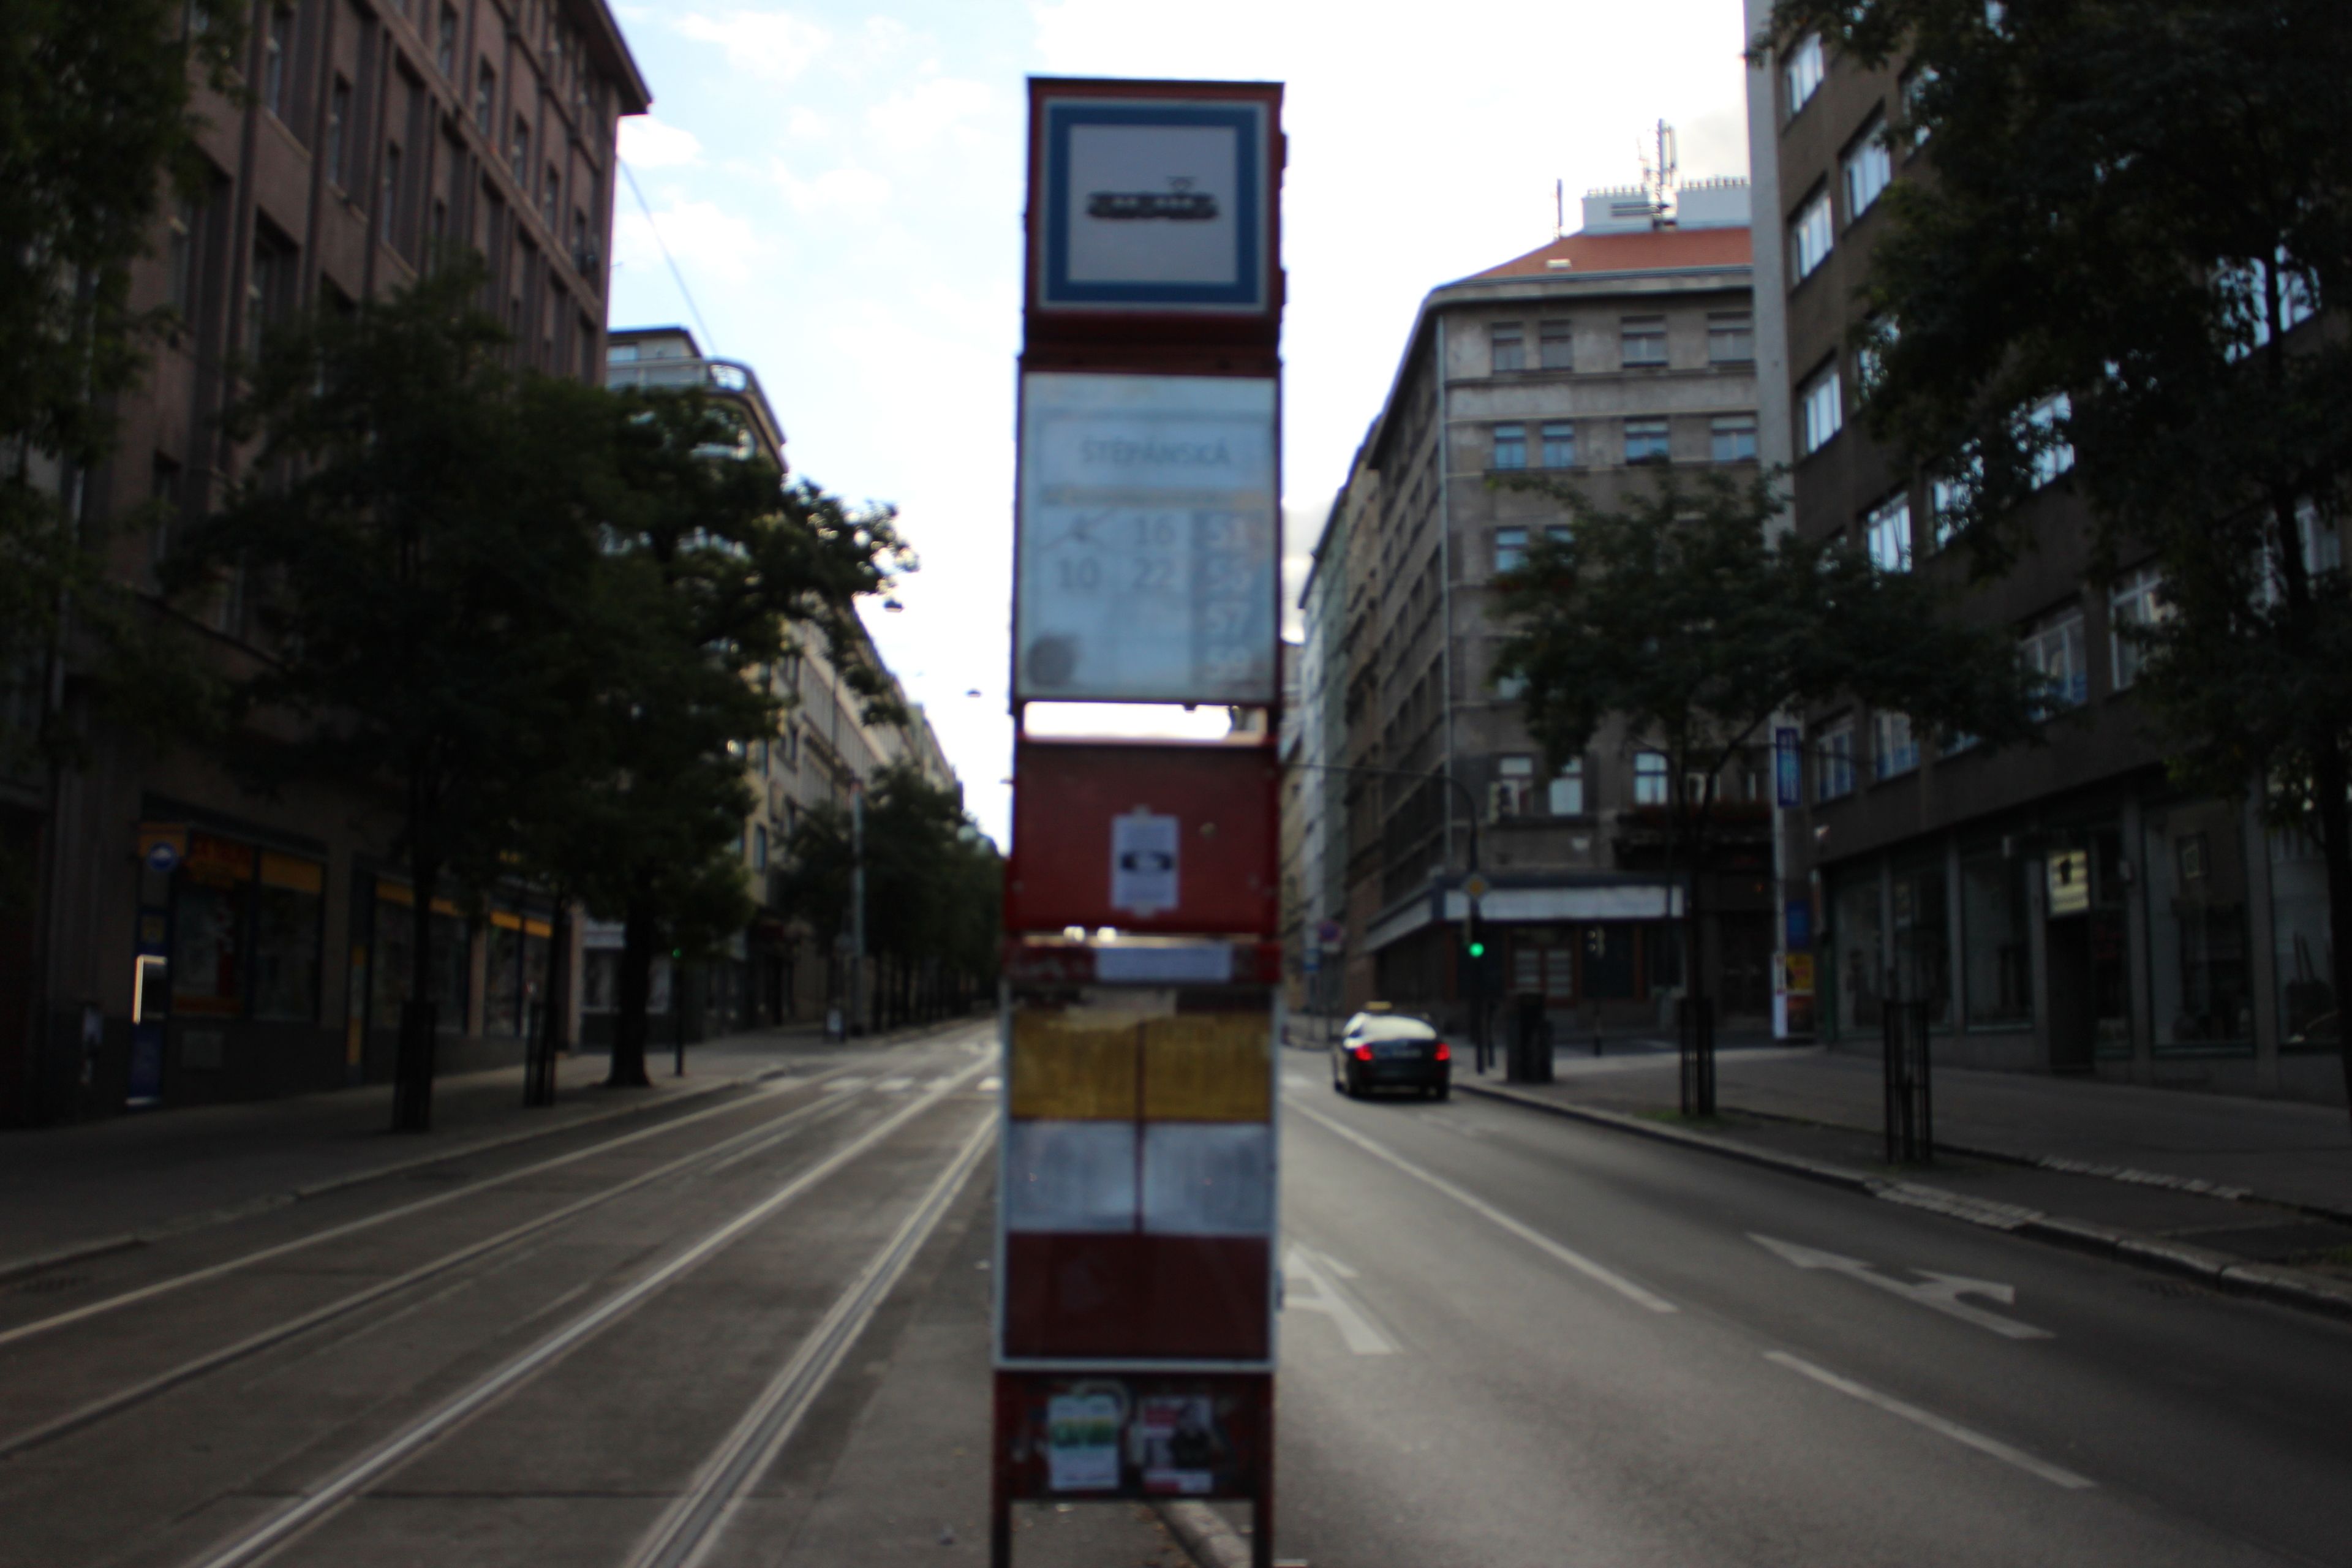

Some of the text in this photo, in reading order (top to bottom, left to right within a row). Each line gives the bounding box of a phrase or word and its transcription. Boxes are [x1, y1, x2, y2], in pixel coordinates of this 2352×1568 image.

[1134, 516, 1176, 546] 16
[1207, 516, 1250, 549] 51
[1057, 557, 1101, 591] 10
[1131, 557, 1175, 590] 22
[1206, 601, 1251, 635] 57
